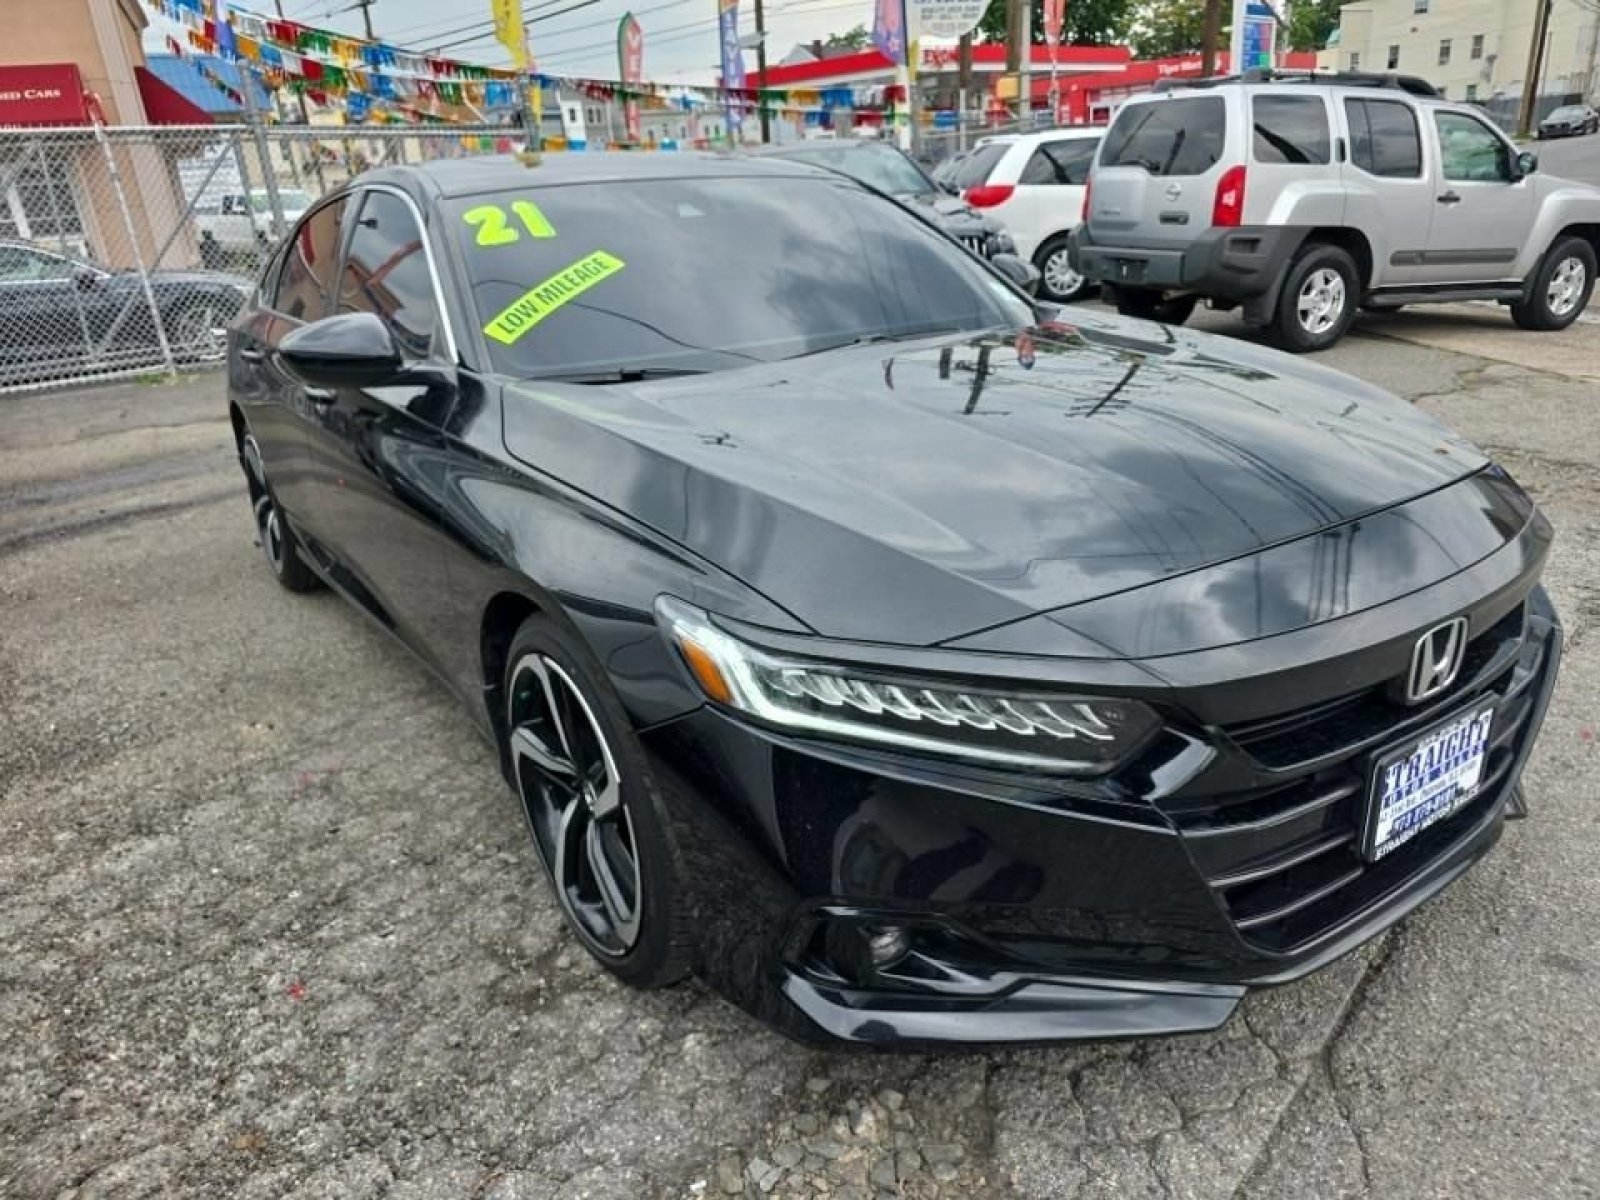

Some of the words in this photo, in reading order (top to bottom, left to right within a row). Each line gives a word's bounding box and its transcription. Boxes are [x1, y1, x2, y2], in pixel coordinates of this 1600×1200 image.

[463, 201, 556, 246] 21
[497, 299, 539, 334] LOW
[534, 257, 609, 306] MILEAGE
